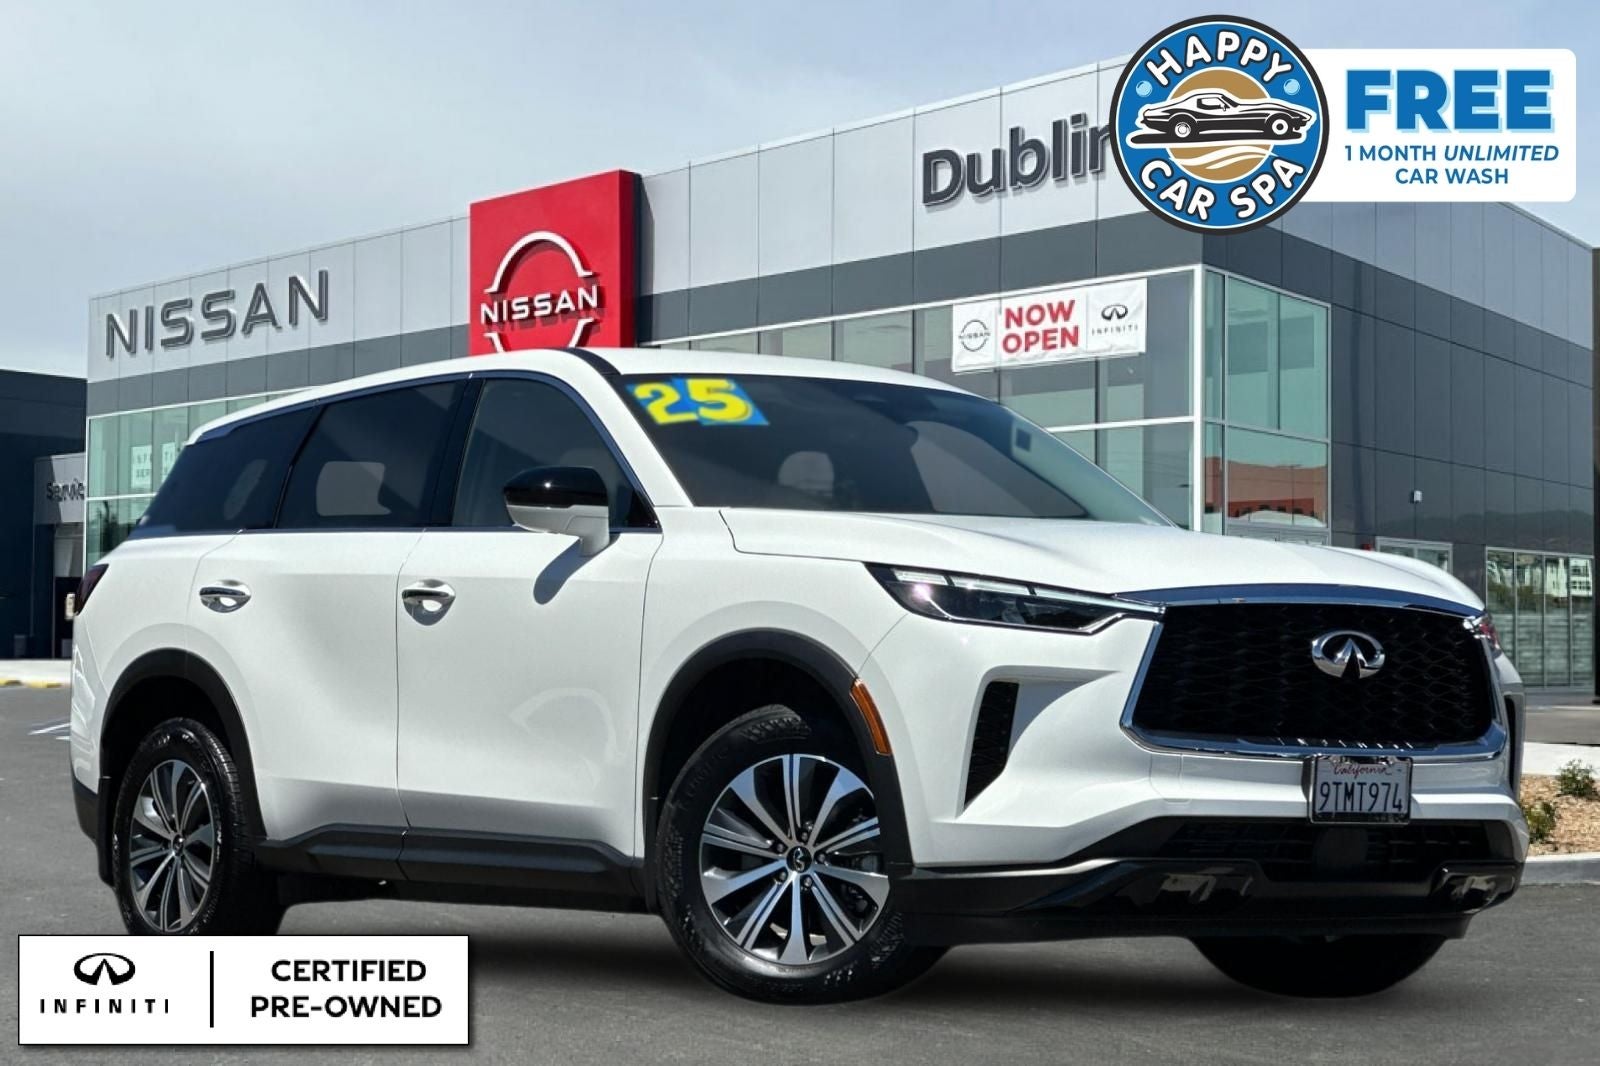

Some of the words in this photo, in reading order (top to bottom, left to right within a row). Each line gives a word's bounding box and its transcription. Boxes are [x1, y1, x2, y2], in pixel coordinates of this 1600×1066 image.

[105, 269, 329, 358] NISSAN
[480, 285, 599, 325] NISSAN
[1005, 299, 1076, 329] NOW
[1002, 325, 1079, 354] OPEN
[1091, 324, 1139, 336] INFINITI
[633, 378, 753, 425] 25
[1333, 762, 1392, 779] California
[1318, 781, 1403, 812] 9TMT974
